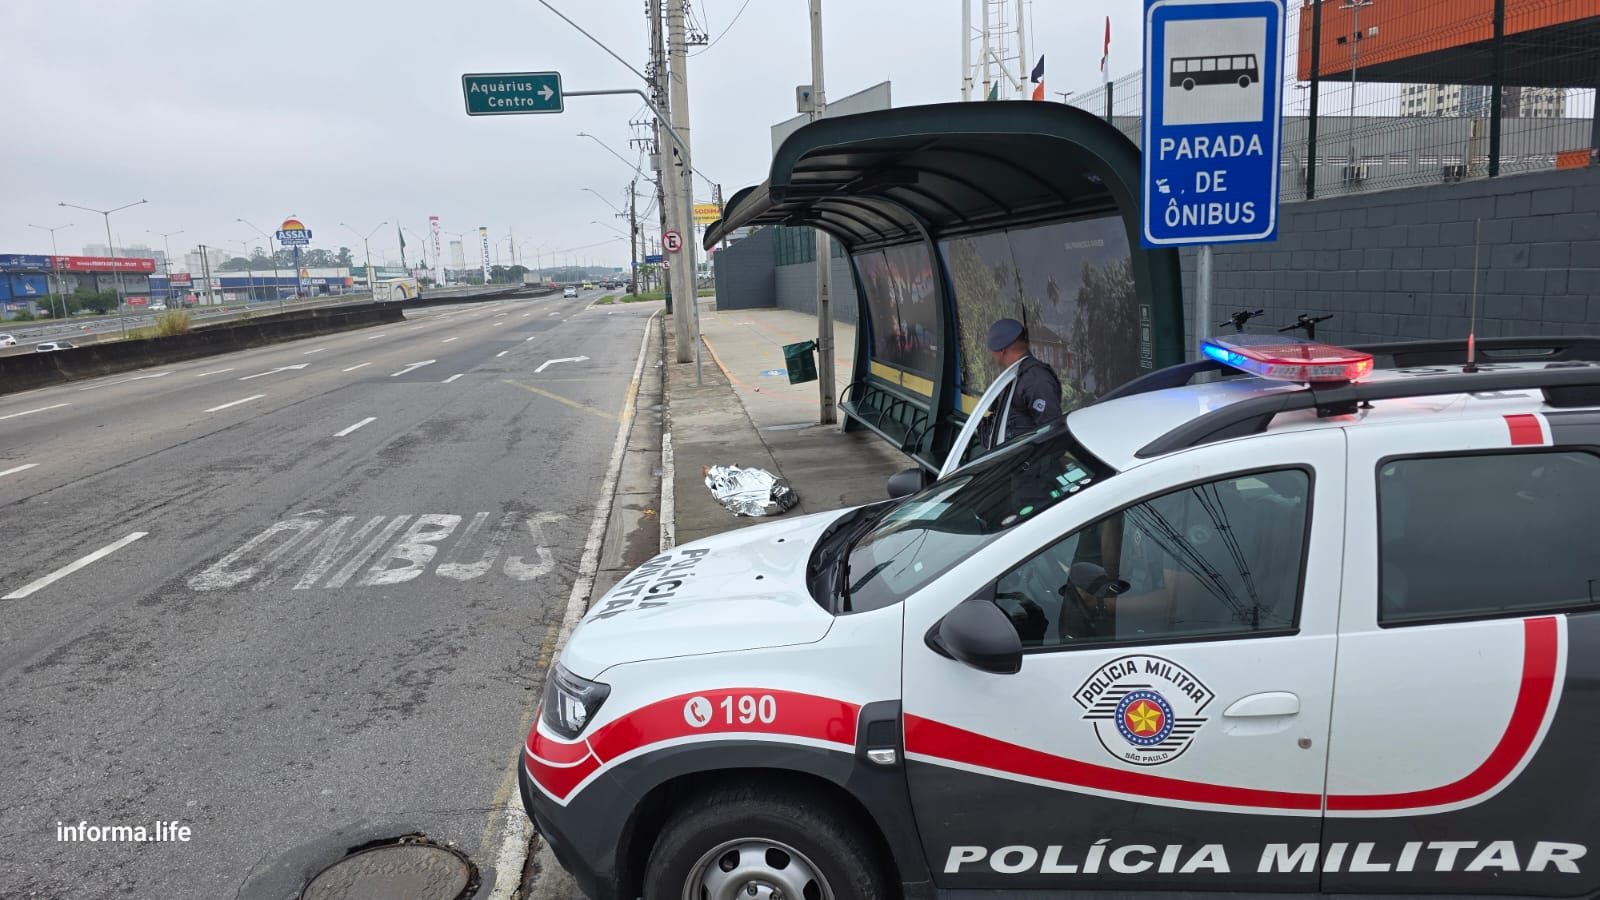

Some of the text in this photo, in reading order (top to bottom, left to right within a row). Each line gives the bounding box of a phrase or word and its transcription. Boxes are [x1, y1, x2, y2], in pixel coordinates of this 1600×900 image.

[470, 80, 533, 95] Aquárius
[488, 96, 534, 107] Centro
[1159, 133, 1264, 161] PARADA
[1195, 170, 1228, 194] DE
[1165, 197, 1256, 228] ÔNIBUS
[669, 235, 677, 248] E
[187, 509, 570, 592] ÔNIBUS
[586, 555, 673, 624] MILITAR
[638, 548, 710, 610] POLÍCIA
[1082, 659, 1205, 704] POLÍCIA MILITAR
[720, 694, 777, 725] 190
[1125, 752, 1168, 762] SÃO PAULO
[943, 838, 1588, 875] POLÍCIA MILITAR
